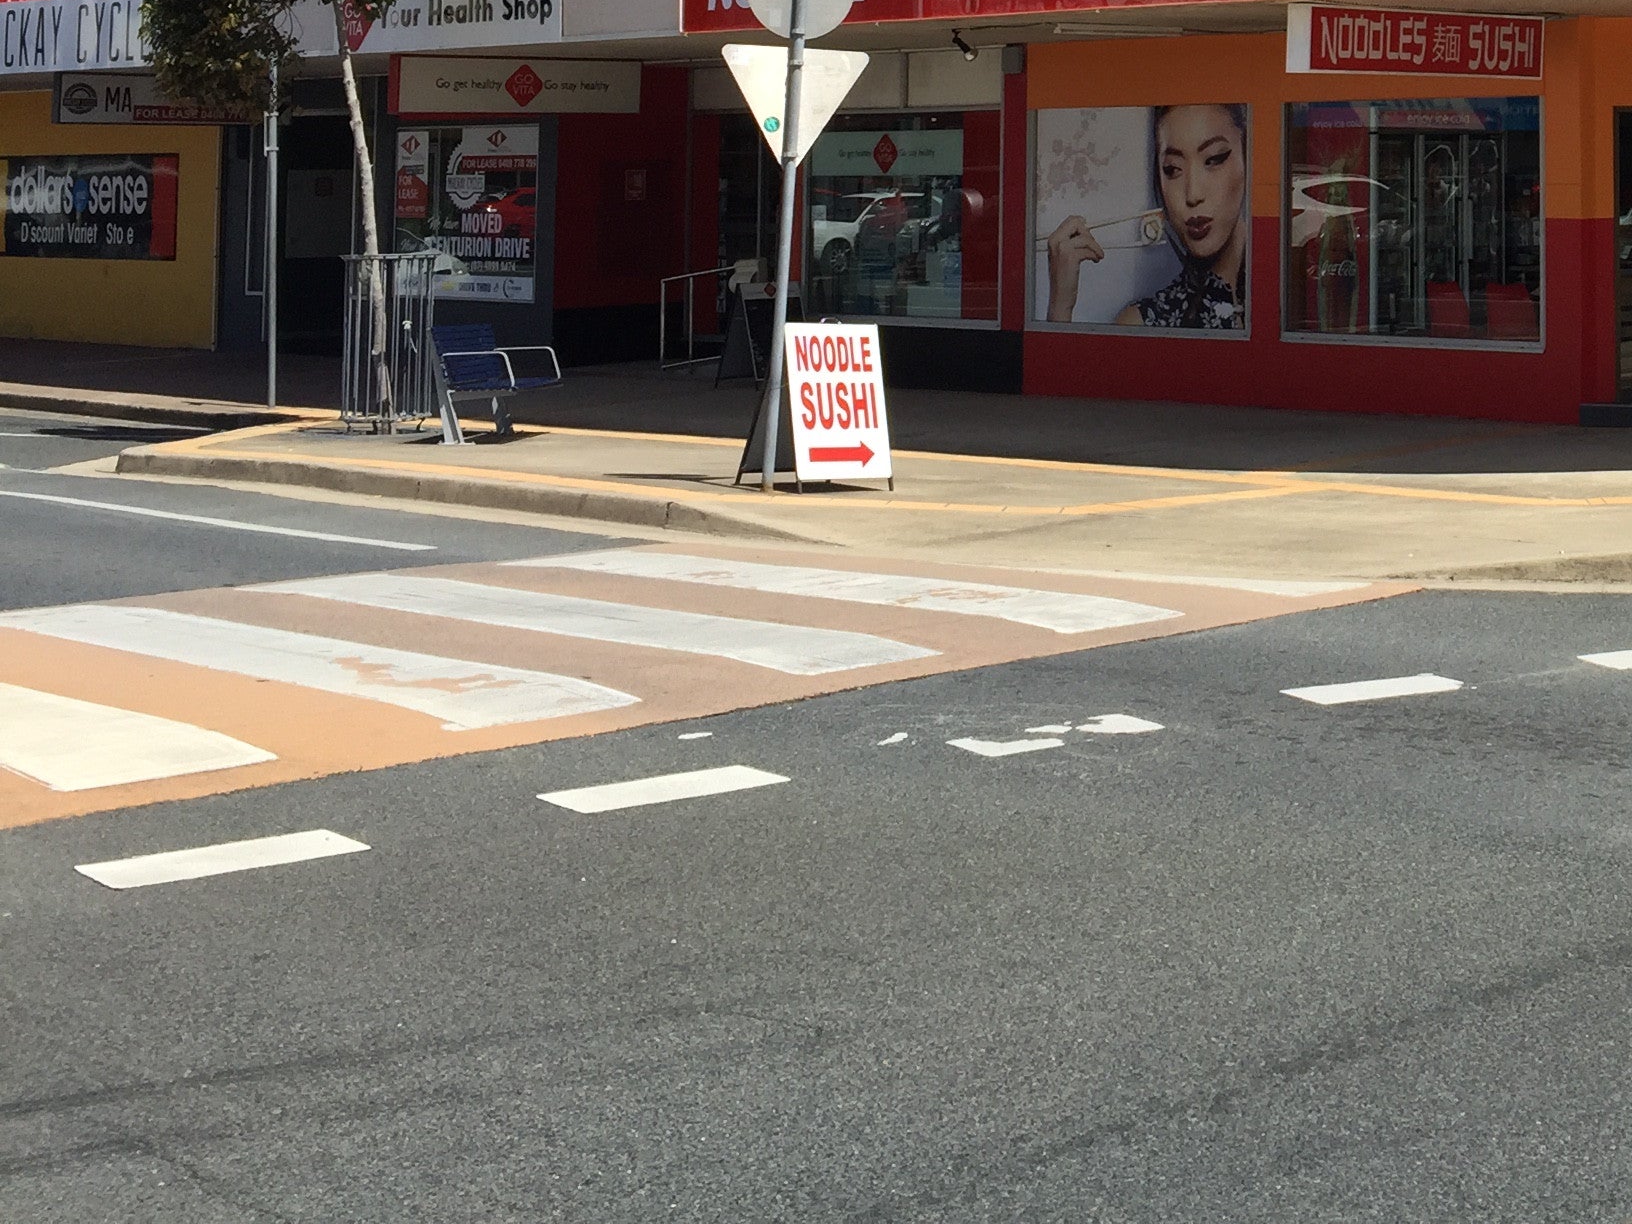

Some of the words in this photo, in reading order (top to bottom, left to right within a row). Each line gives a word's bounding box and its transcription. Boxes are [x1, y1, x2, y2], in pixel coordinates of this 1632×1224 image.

[1321, 13, 1427, 64] NOODLES
[1468, 20, 1535, 71] SUSHI
[436, 78, 451, 89] Go
[544, 79, 558, 90] Go
[136, 109, 159, 120] FOR
[88, 175, 148, 214] sense
[21, 222, 64, 243] Dscount
[67, 223, 98, 244] Variet
[106, 222, 135, 245] Stoe
[461, 213, 503, 234] MOVED
[495, 238, 530, 258] DRIVE
[794, 335, 873, 372] NOODLE
[800, 381, 878, 430] SUSHI
